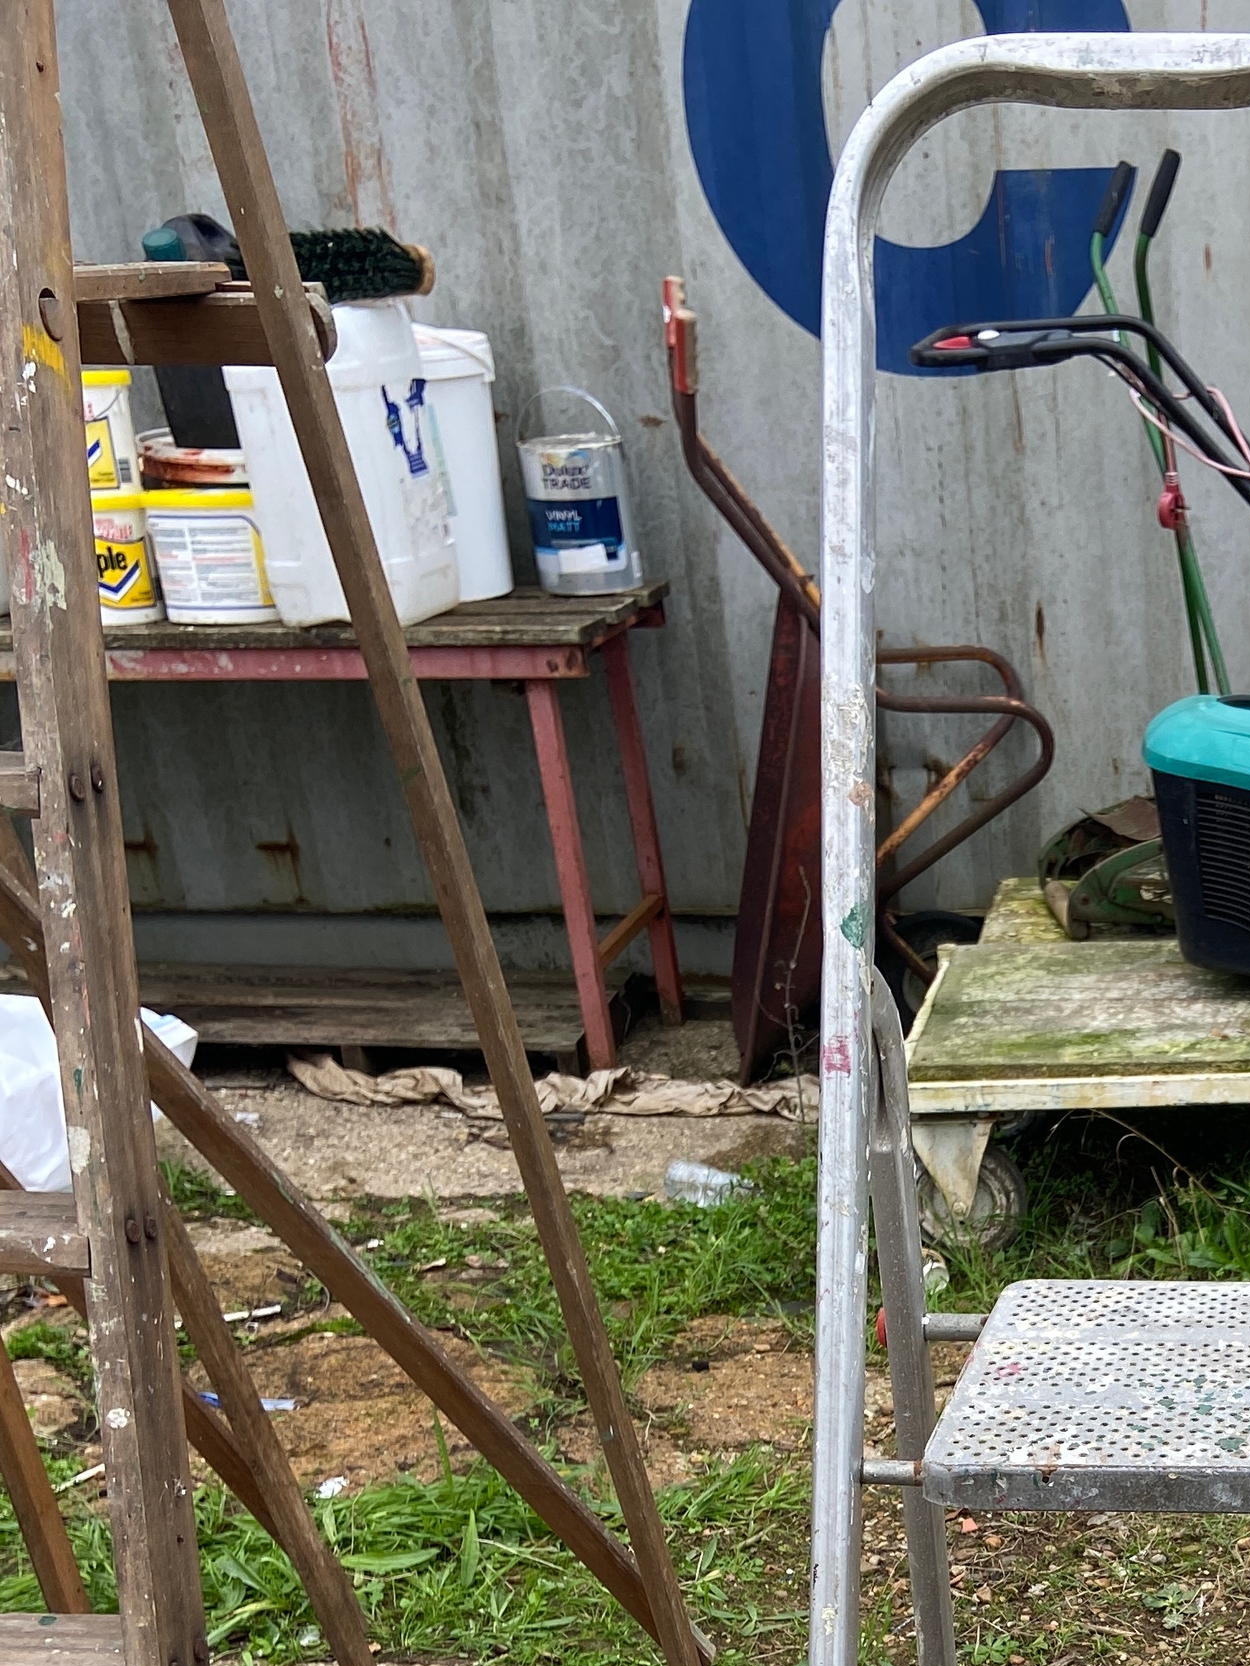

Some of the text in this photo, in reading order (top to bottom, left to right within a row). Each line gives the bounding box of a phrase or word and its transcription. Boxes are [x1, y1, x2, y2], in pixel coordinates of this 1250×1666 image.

[542, 477, 592, 490] TRADE
[545, 510, 583, 521] VINYL
[548, 522, 580, 532] MATT
